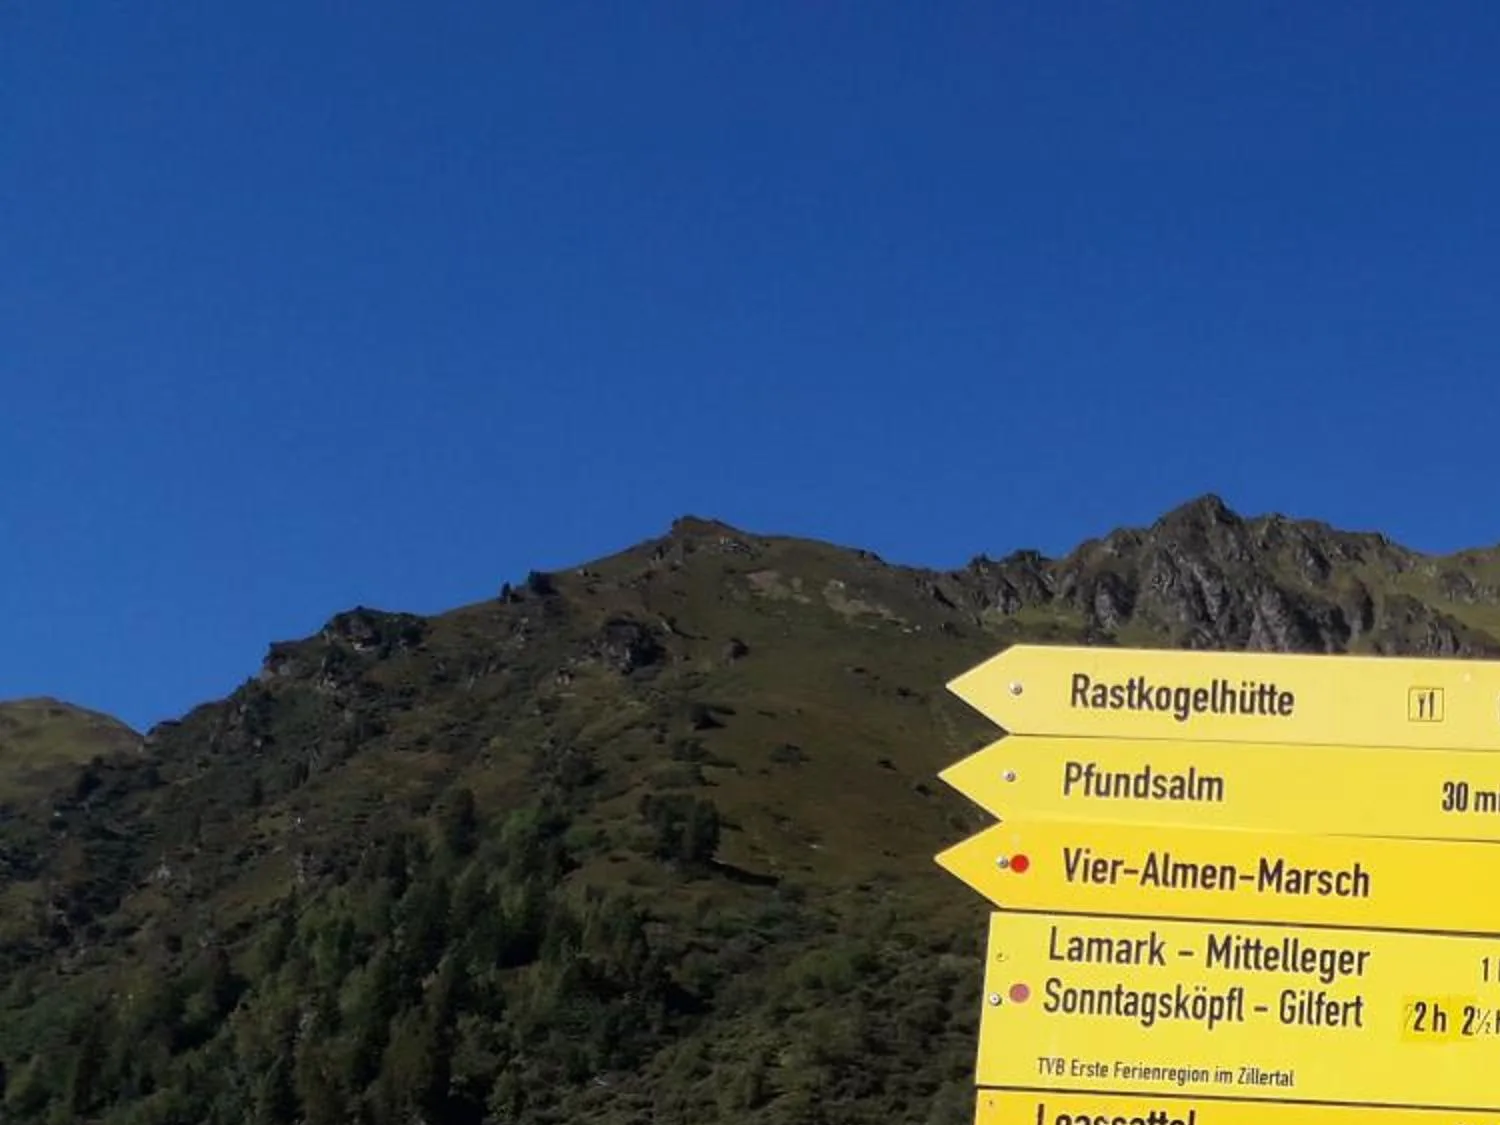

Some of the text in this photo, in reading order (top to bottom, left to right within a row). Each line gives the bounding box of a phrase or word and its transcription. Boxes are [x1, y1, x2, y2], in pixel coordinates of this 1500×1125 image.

[1071, 673, 1295, 721] Rastkogelhütte
[1063, 761, 1224, 801] Pfundsalm
[1442, 781, 1468, 811] 30
[1063, 847, 1370, 897] Vier-Almen-Marsch
[1049, 925, 1166, 966] Lamark
[1206, 933, 1370, 984] Mittelleger
[1482, 958, 1489, 982] 1
[1044, 977, 1244, 1029] Sonntagsköpfl
[1280, 989, 1363, 1027] Gilfert
[1413, 1002, 1426, 1032] 2
[1433, 1003, 1447, 1032] h
[1038, 1057, 1295, 1087] TVB Erste Ferienregion im Zillertal
